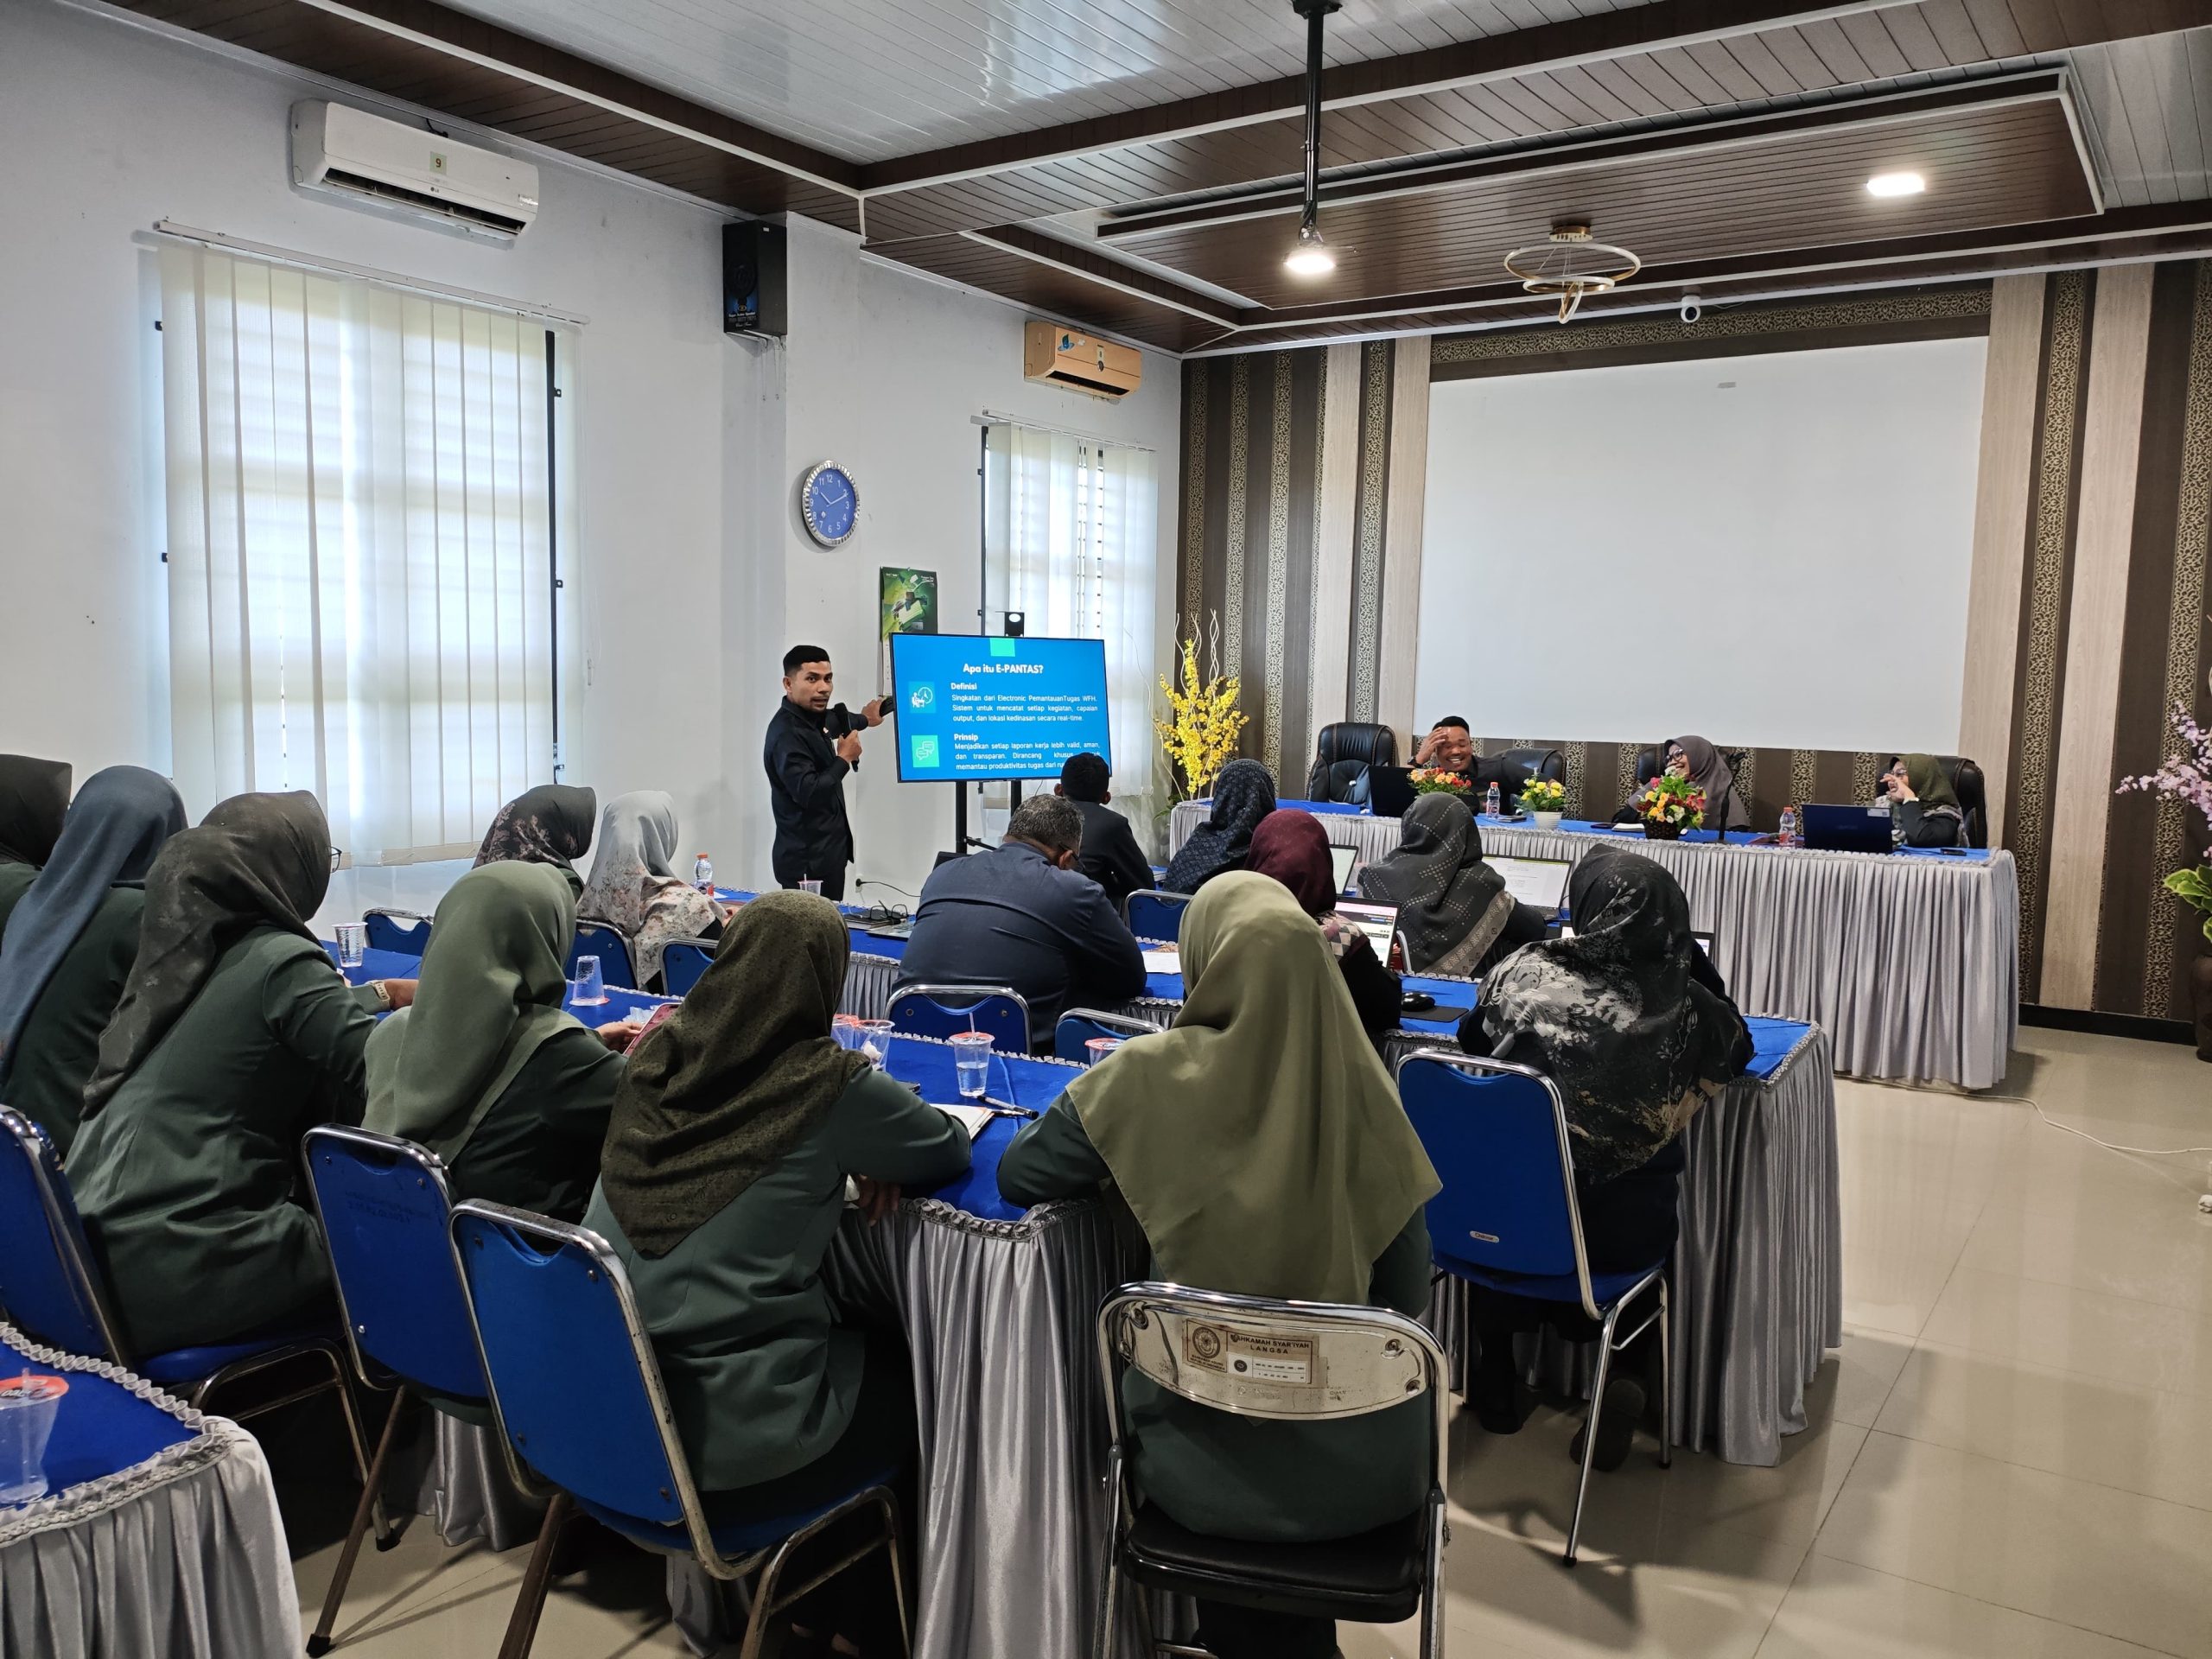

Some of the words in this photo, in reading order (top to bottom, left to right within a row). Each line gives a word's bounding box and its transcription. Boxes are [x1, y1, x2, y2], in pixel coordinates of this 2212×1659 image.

[435, 158, 441, 167] 9
[826, 474, 833, 483] 12
[812, 486, 819, 495] 10
[810, 498, 814, 506] 9
[843, 514, 847, 522] 4
[963, 663, 981, 674] Apa
[983, 664, 994, 673] itu
[996, 664, 1044, 674] E-PANTAS?
[1250, 1345, 1288, 1354] LANGSA
